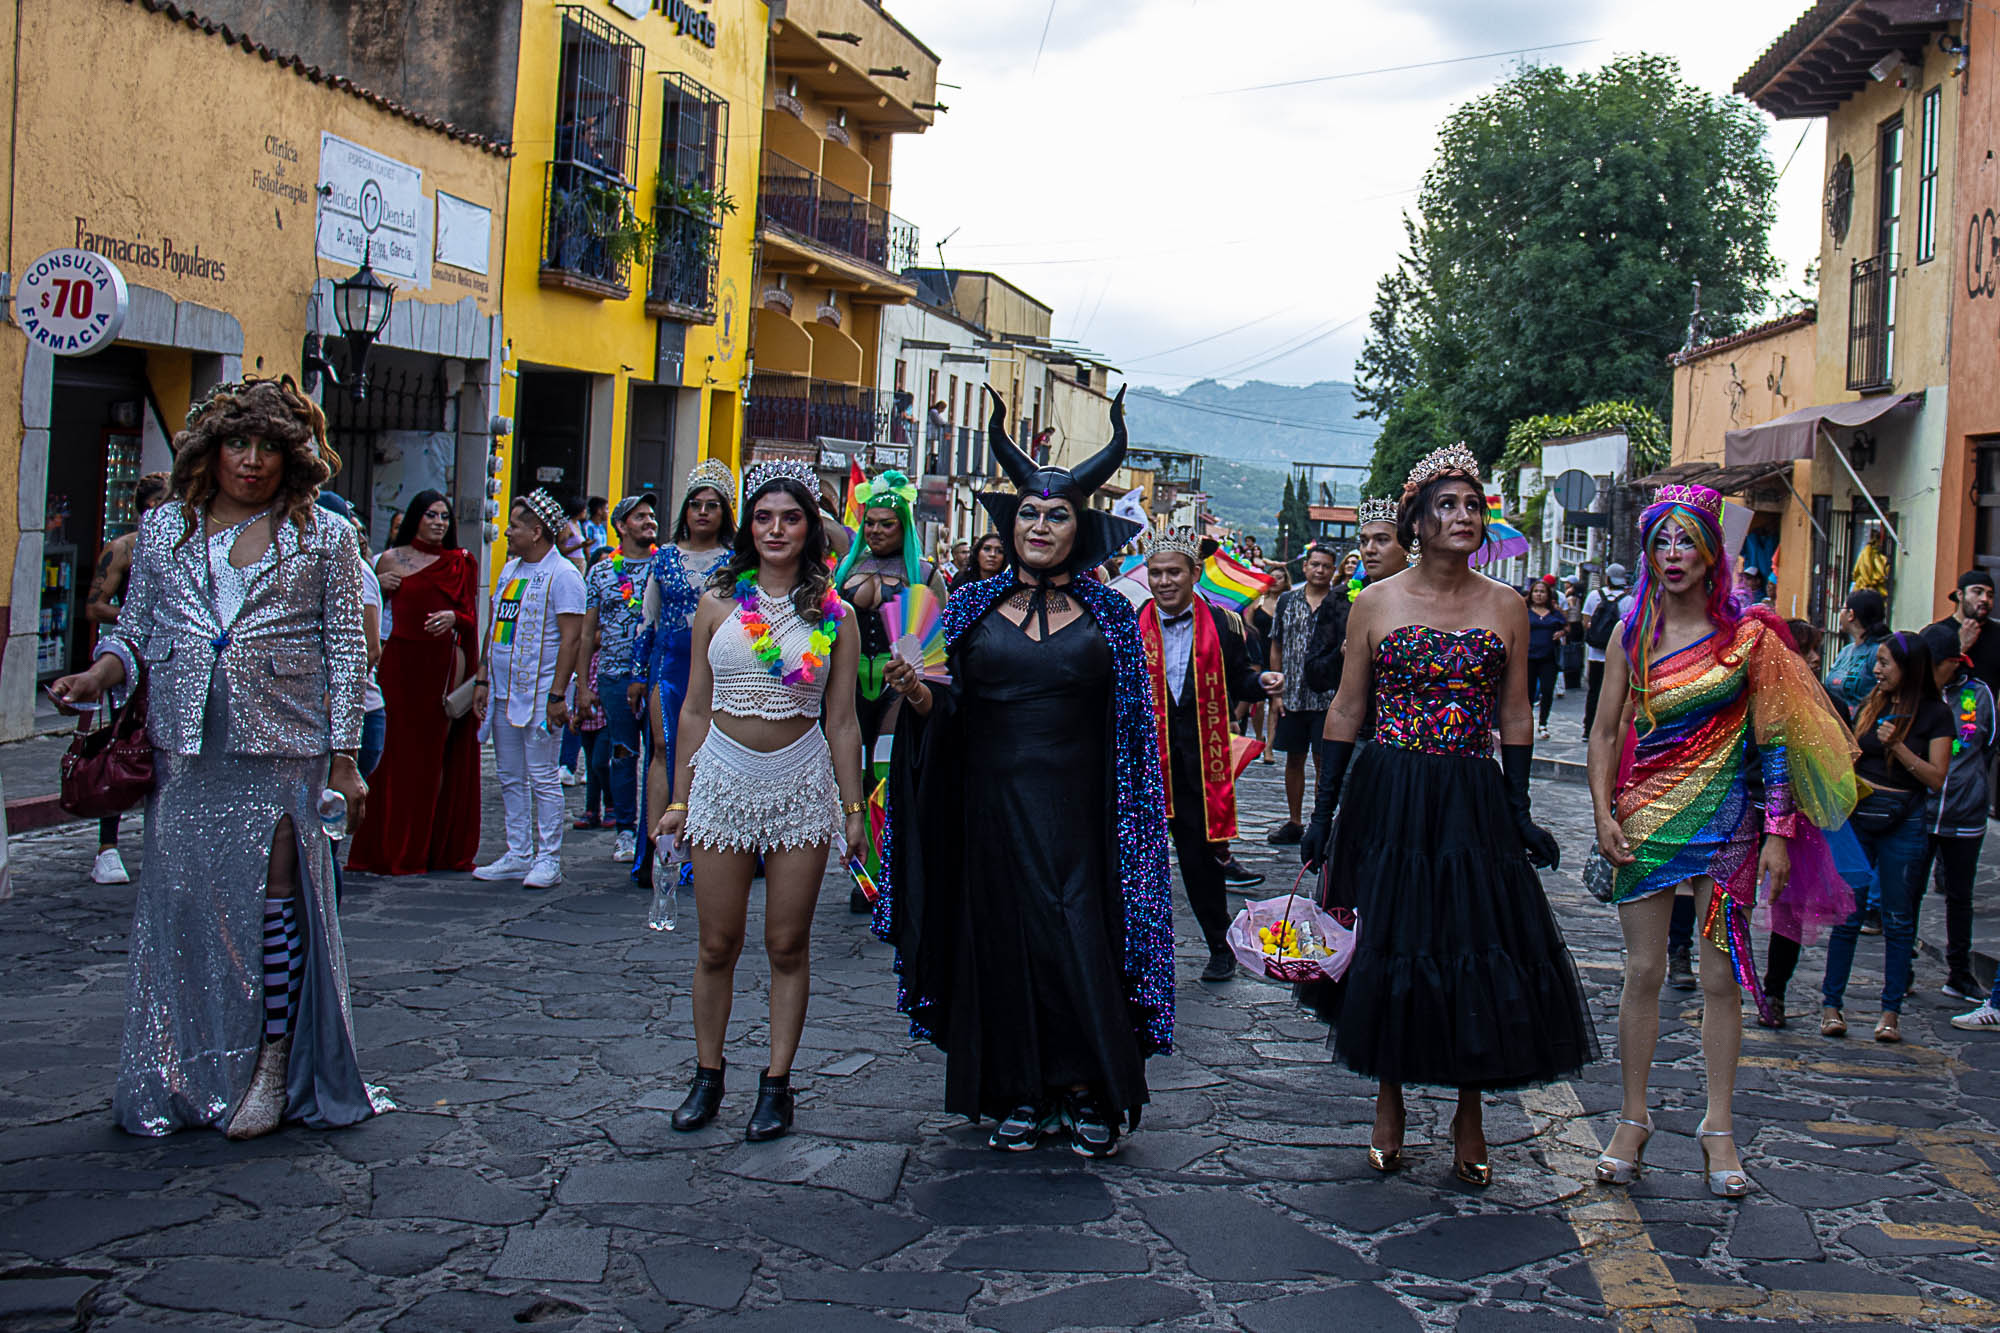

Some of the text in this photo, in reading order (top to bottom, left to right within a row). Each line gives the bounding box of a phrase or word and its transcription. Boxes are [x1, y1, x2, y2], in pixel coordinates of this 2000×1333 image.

[252, 168, 308, 206] Fisioterapia
[276, 160, 285, 177] de
[382, 201, 416, 229] Dental
[75, 216, 226, 281] Farmacias Populares
[27, 254, 109, 290] CONSULTA
[40, 279, 94, 320] $70
[22, 306, 110, 349] FARMACIA
[1205, 671, 1225, 773] HISPANO
